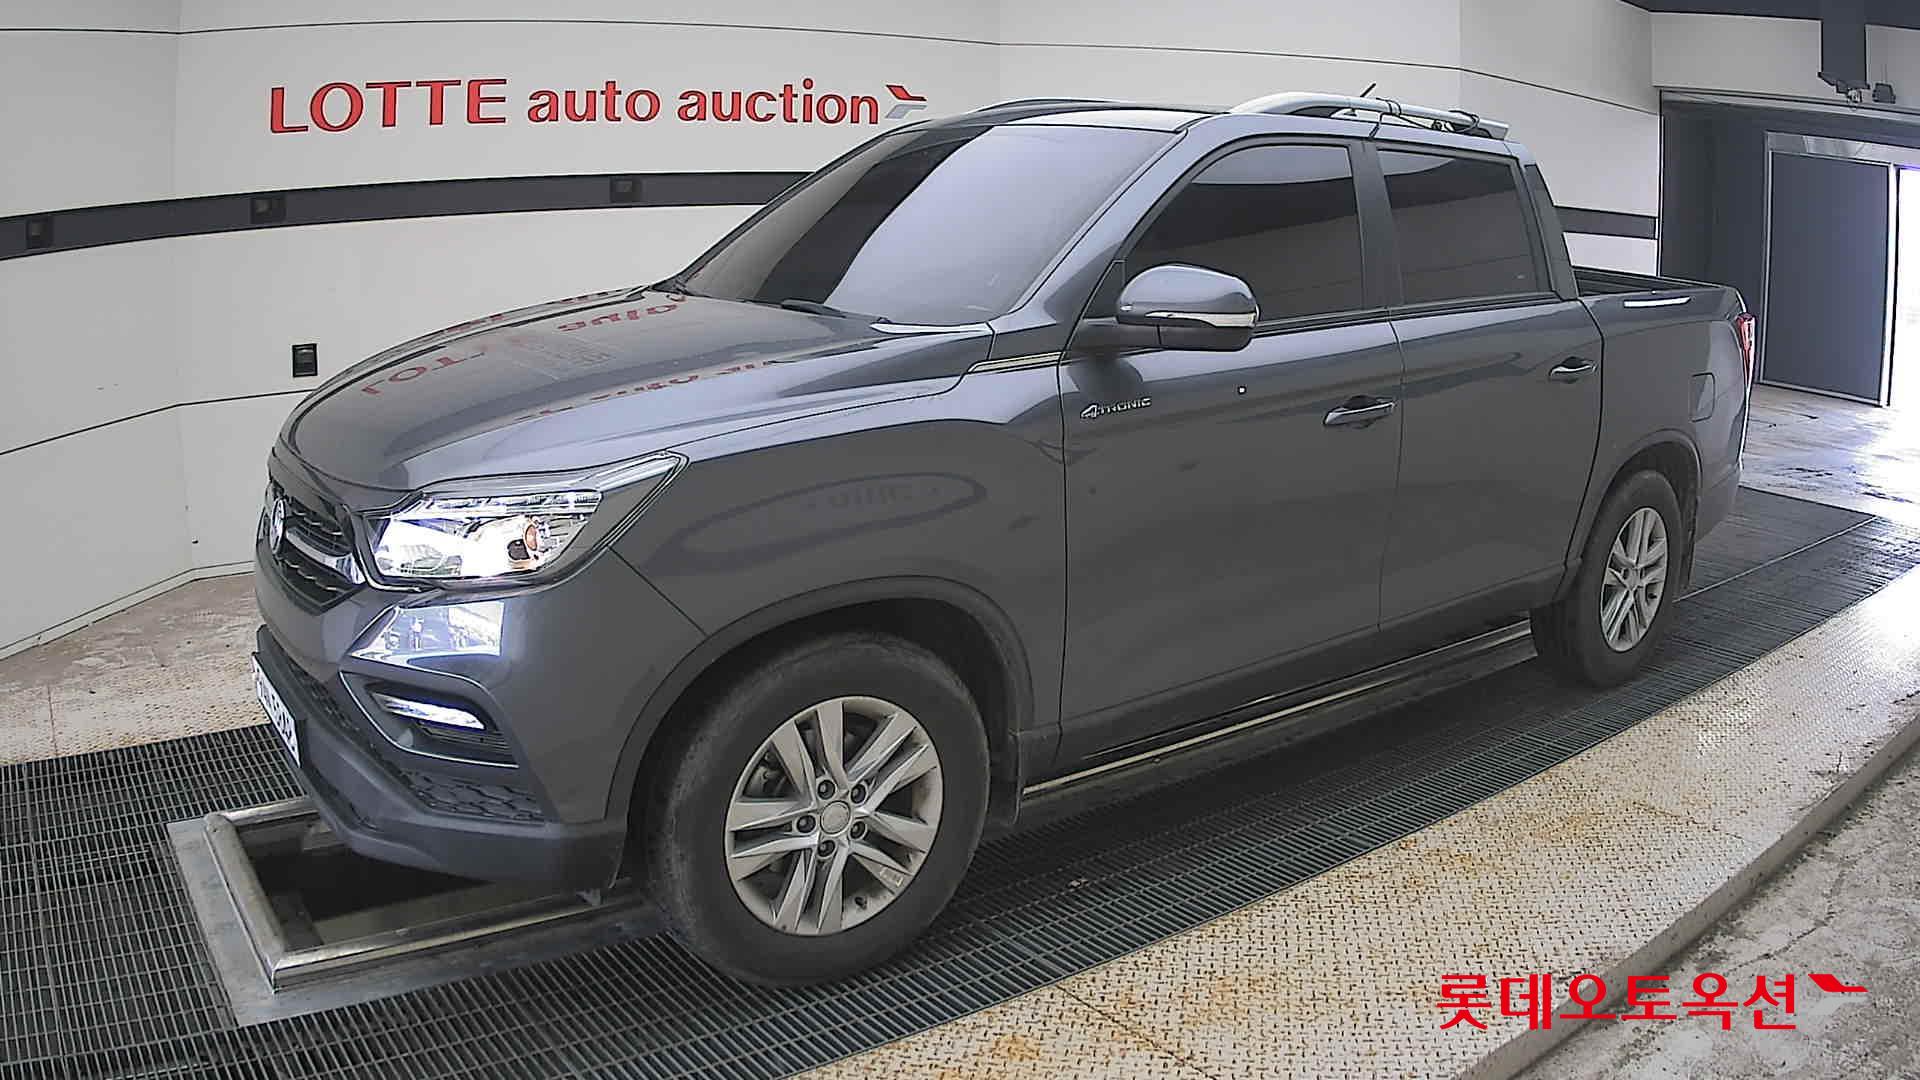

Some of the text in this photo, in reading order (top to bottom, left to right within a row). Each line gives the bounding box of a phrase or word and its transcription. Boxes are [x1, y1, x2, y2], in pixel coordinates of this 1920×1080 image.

[270, 79, 880, 134] LOTTE auto auction
